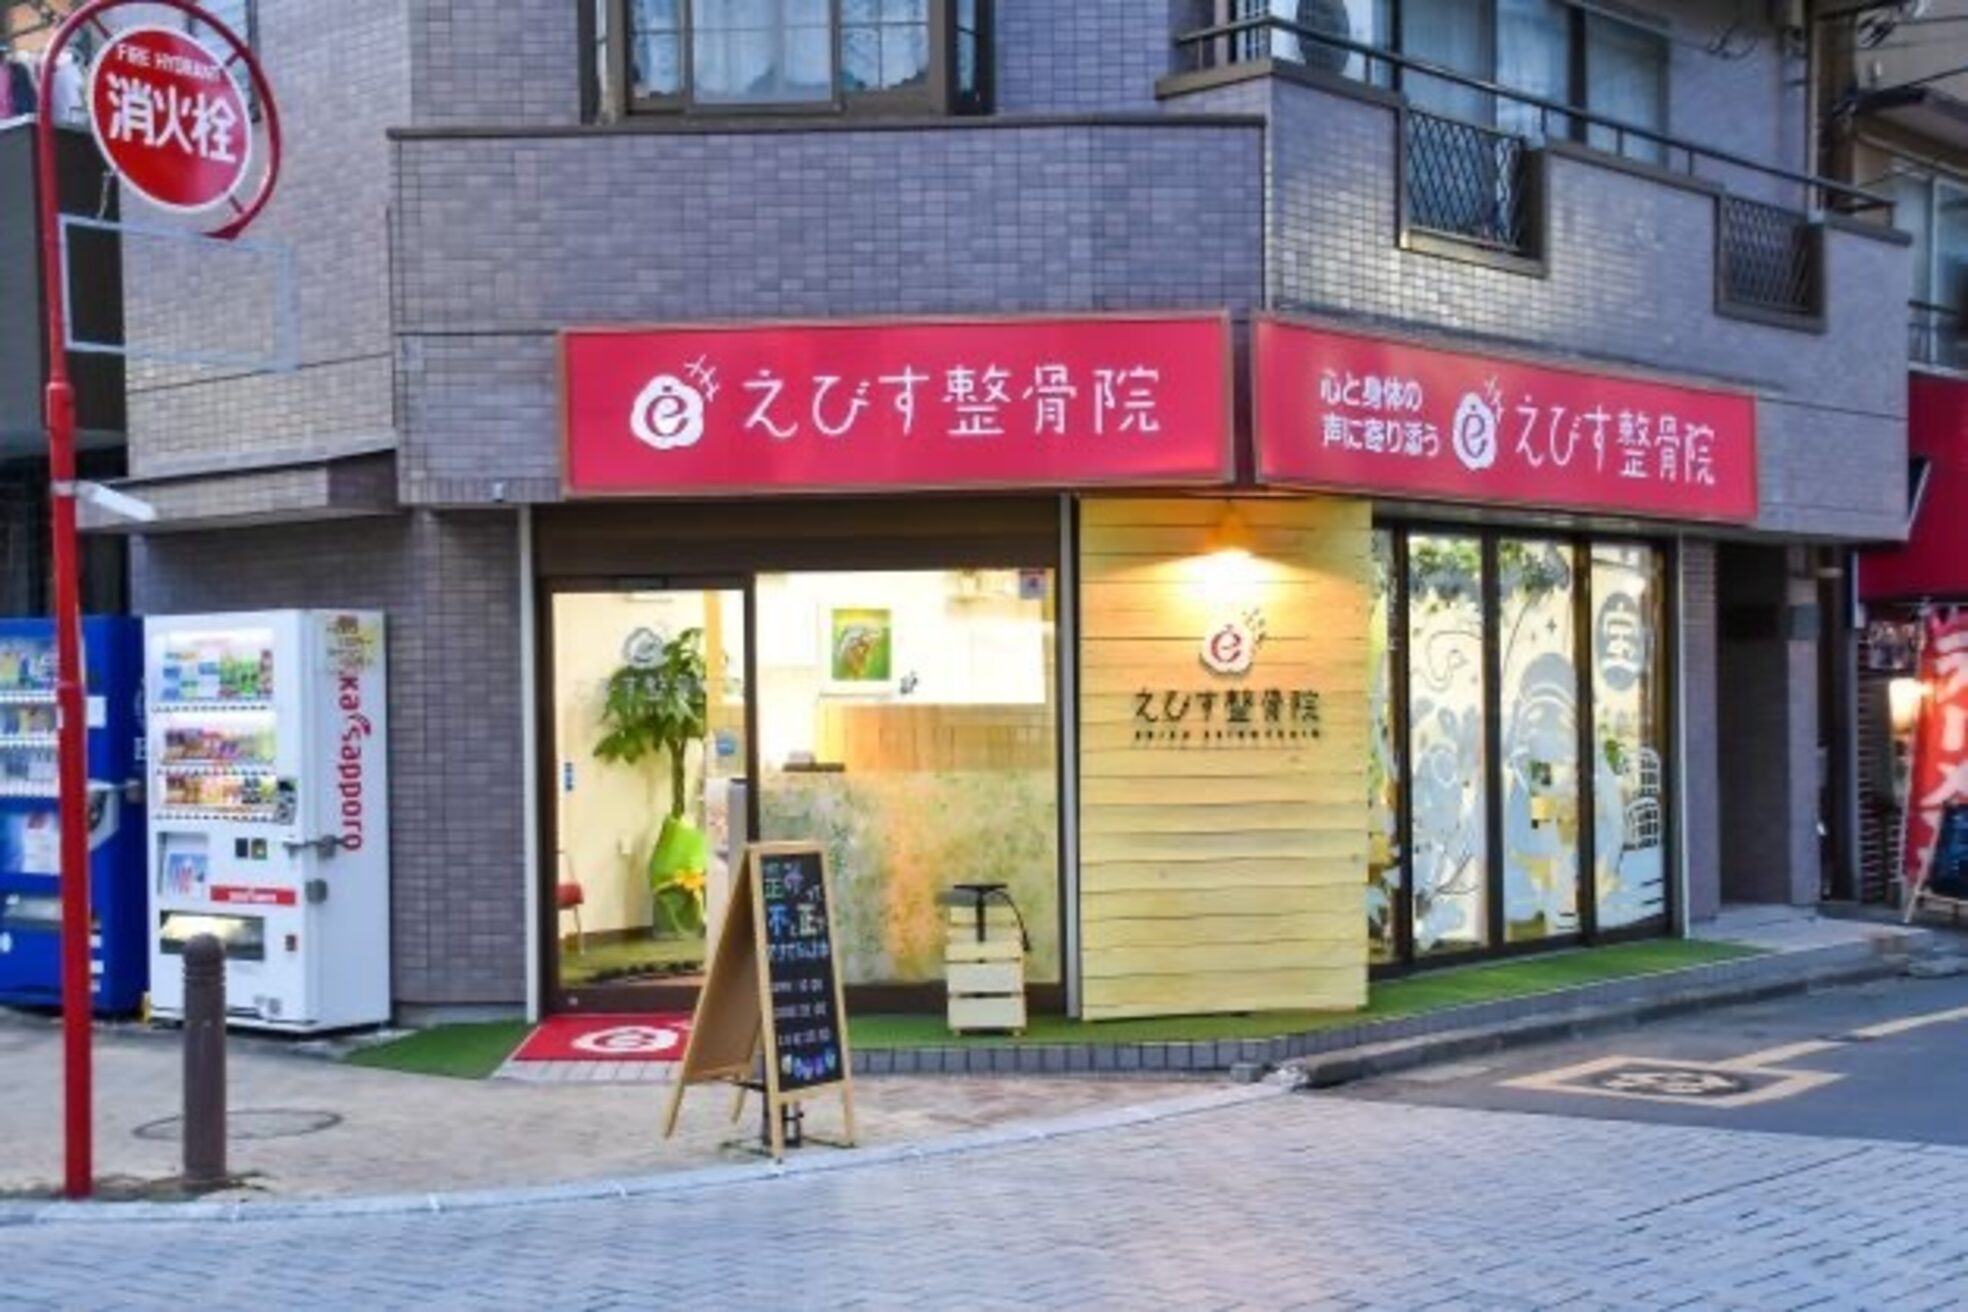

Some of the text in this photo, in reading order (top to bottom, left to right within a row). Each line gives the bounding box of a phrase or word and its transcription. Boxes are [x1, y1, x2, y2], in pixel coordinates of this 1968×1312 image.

[107, 71, 236, 163] 消火栓
[743, 364, 1160, 438] えびす整骨院
[1320, 370, 1424, 412] 心と身体の
[1516, 394, 1715, 485] えびす整骨院
[1135, 687, 1320, 723] えびす整骨院
